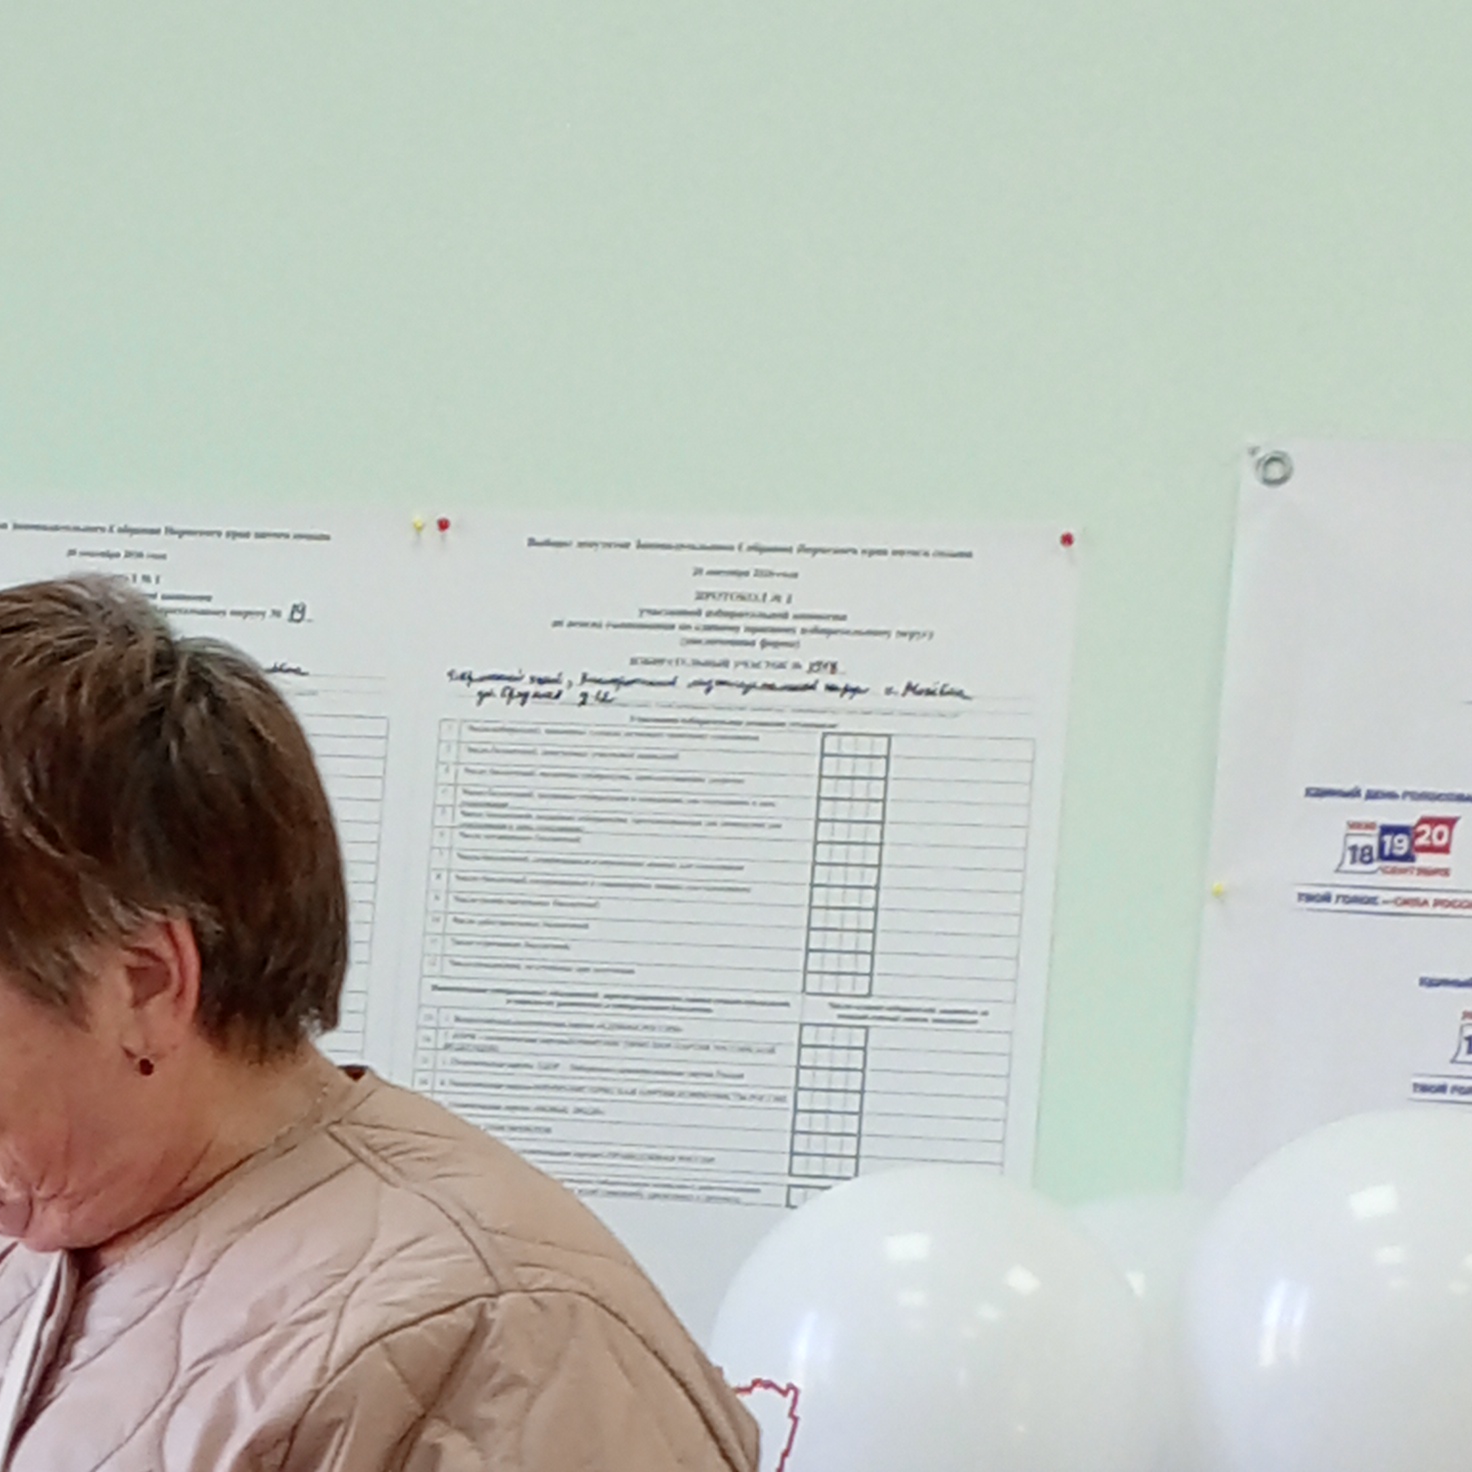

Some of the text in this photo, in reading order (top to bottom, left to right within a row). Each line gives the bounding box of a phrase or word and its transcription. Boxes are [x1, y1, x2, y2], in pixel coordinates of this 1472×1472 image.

[1347, 825, 1450, 865] 18 19 20
